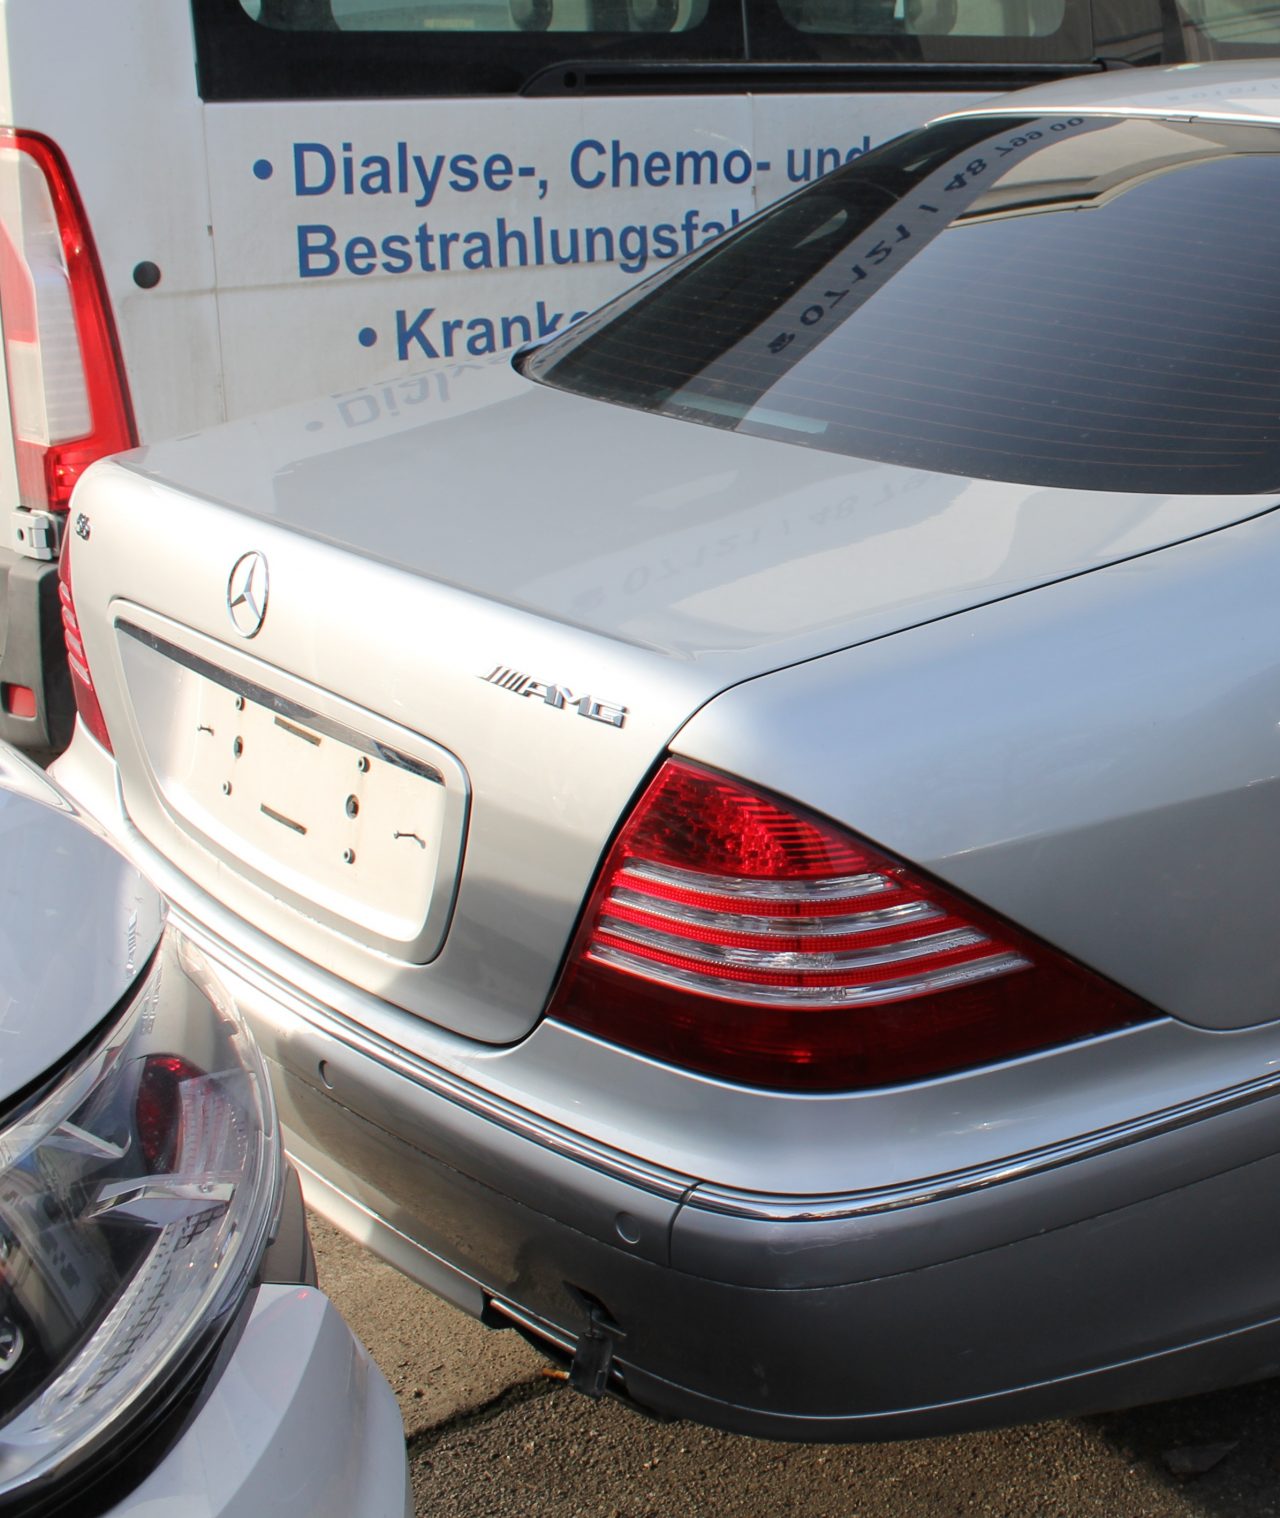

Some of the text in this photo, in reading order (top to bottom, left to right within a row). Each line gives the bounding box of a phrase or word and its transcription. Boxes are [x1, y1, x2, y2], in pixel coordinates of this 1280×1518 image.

[293, 141, 548, 207] Dialyse-,
[570, 139, 771, 189] Chemo-
[297, 209, 740, 278] Bestrahlungsf
[480, 665, 629, 729] AMG
